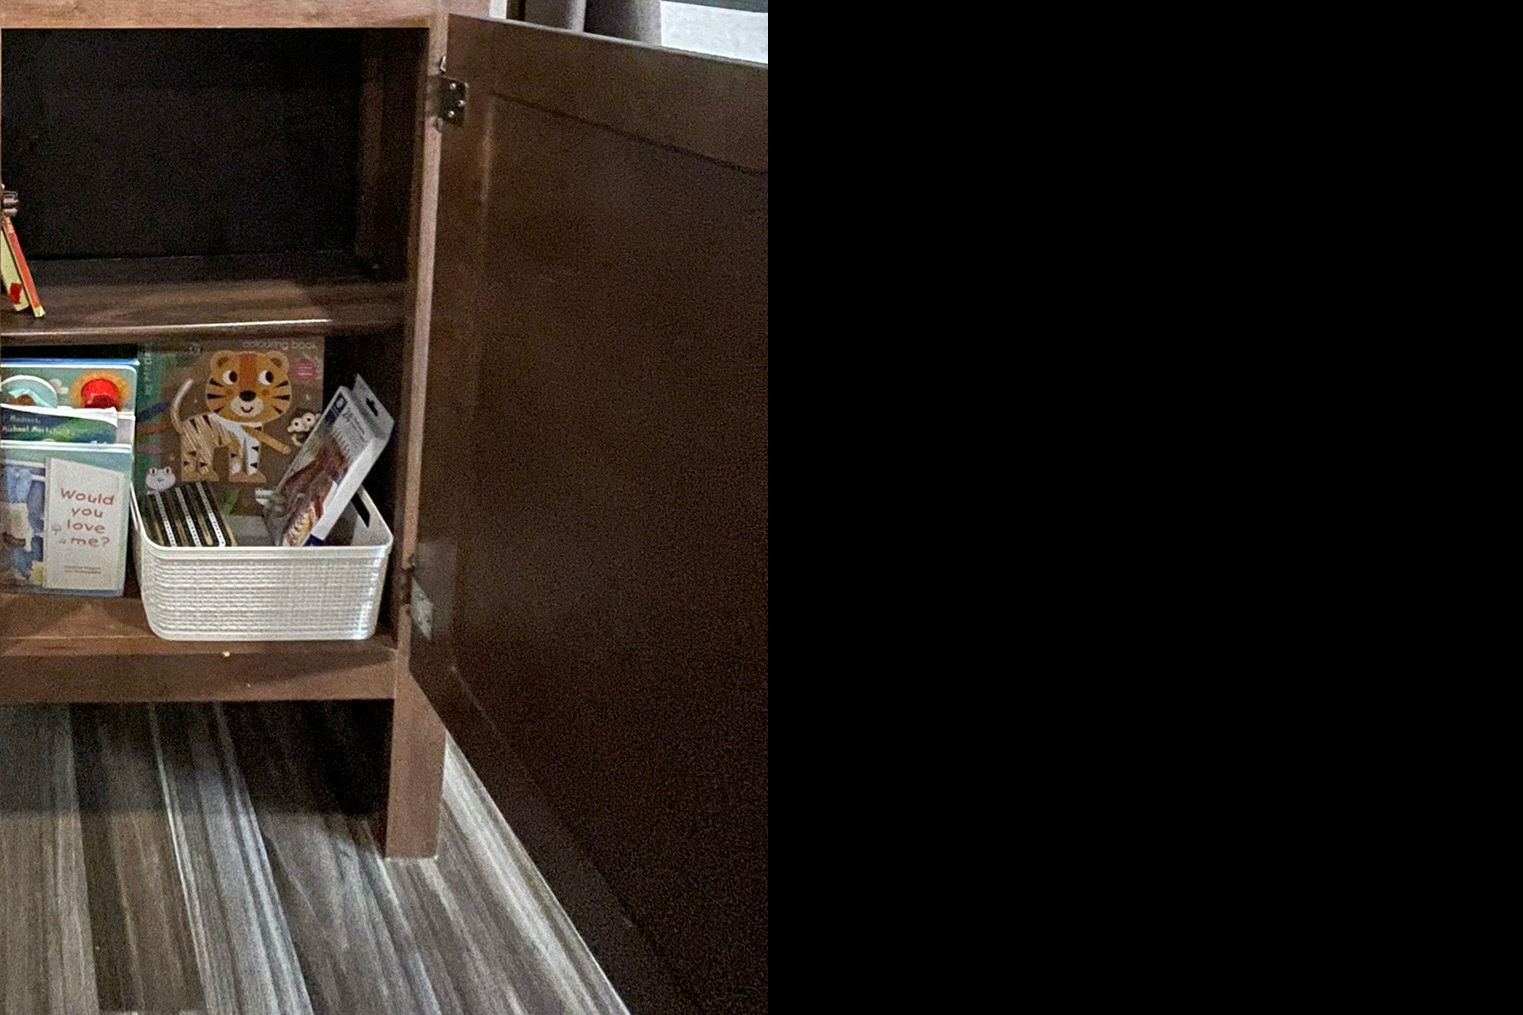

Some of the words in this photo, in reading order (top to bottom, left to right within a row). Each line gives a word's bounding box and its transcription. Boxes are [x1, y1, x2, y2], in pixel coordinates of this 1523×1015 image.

[60, 487, 115, 505] Would
[71, 507, 104, 519] you
[67, 519, 106, 534] love
[71, 536, 111, 548] me?
